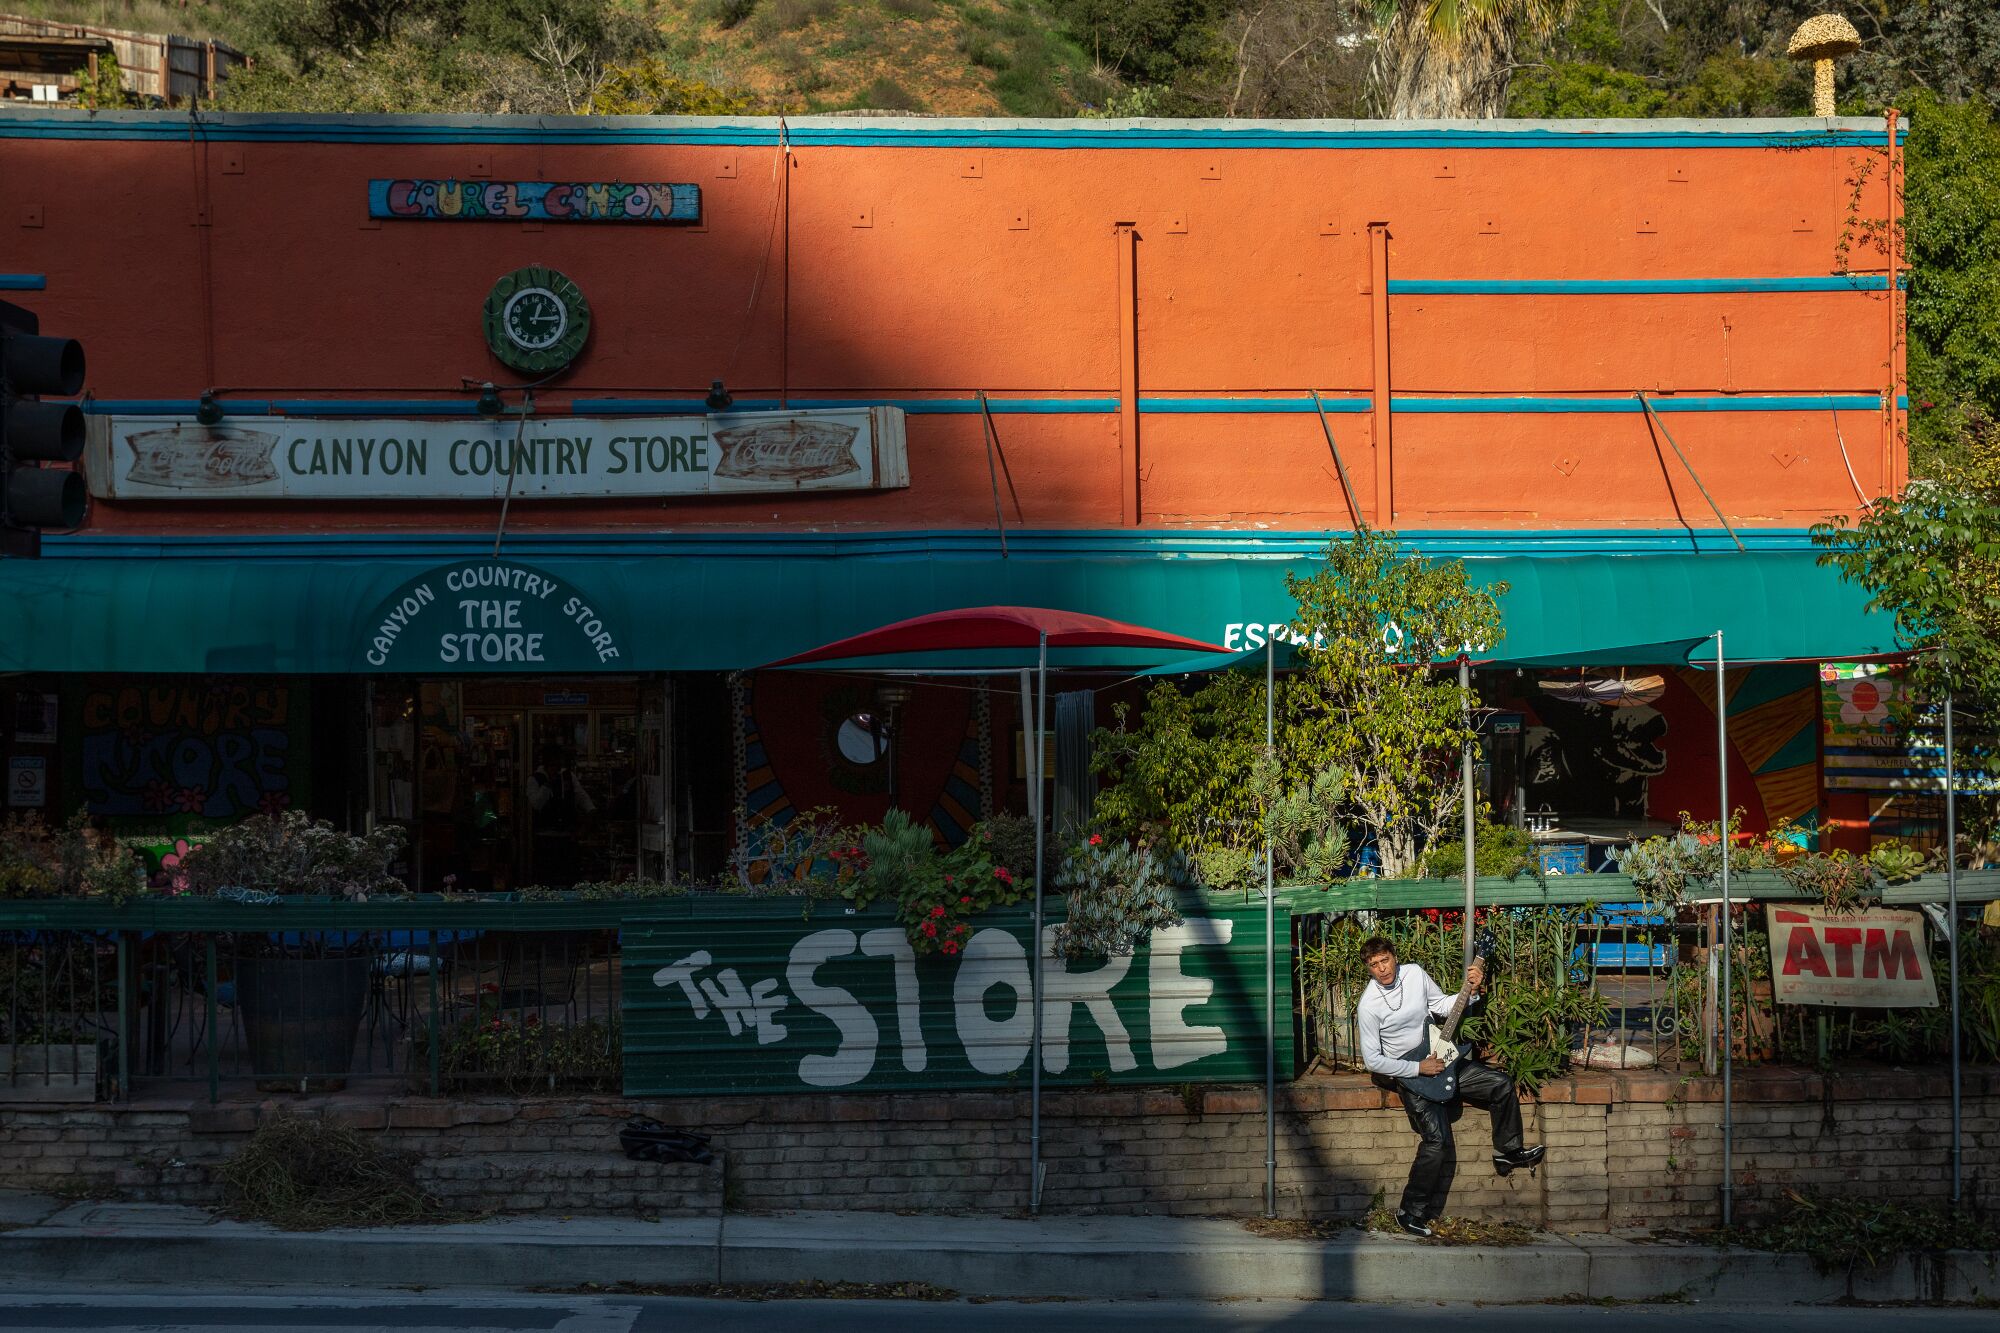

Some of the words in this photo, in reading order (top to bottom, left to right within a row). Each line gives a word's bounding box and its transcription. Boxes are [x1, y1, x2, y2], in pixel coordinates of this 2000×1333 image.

[386, 181, 530, 218] LAUREL
[543, 183, 674, 218] CANYON
[288, 438, 427, 476] CANYON
[449, 436, 593, 476] COUNTRY
[605, 434, 709, 474] STORE
[366, 583, 435, 666] CANYON
[446, 566, 556, 599] COUNTRY
[562, 596, 620, 664] STORE
[459, 600, 522, 629] THE
[440, 633, 545, 662] STORE
[83, 686, 290, 738] COUNTRY
[81, 728, 290, 819] STORE
[1782, 926, 1924, 981] ATM
[653, 949, 788, 1045] THE
[786, 918, 1233, 1086] STORE
